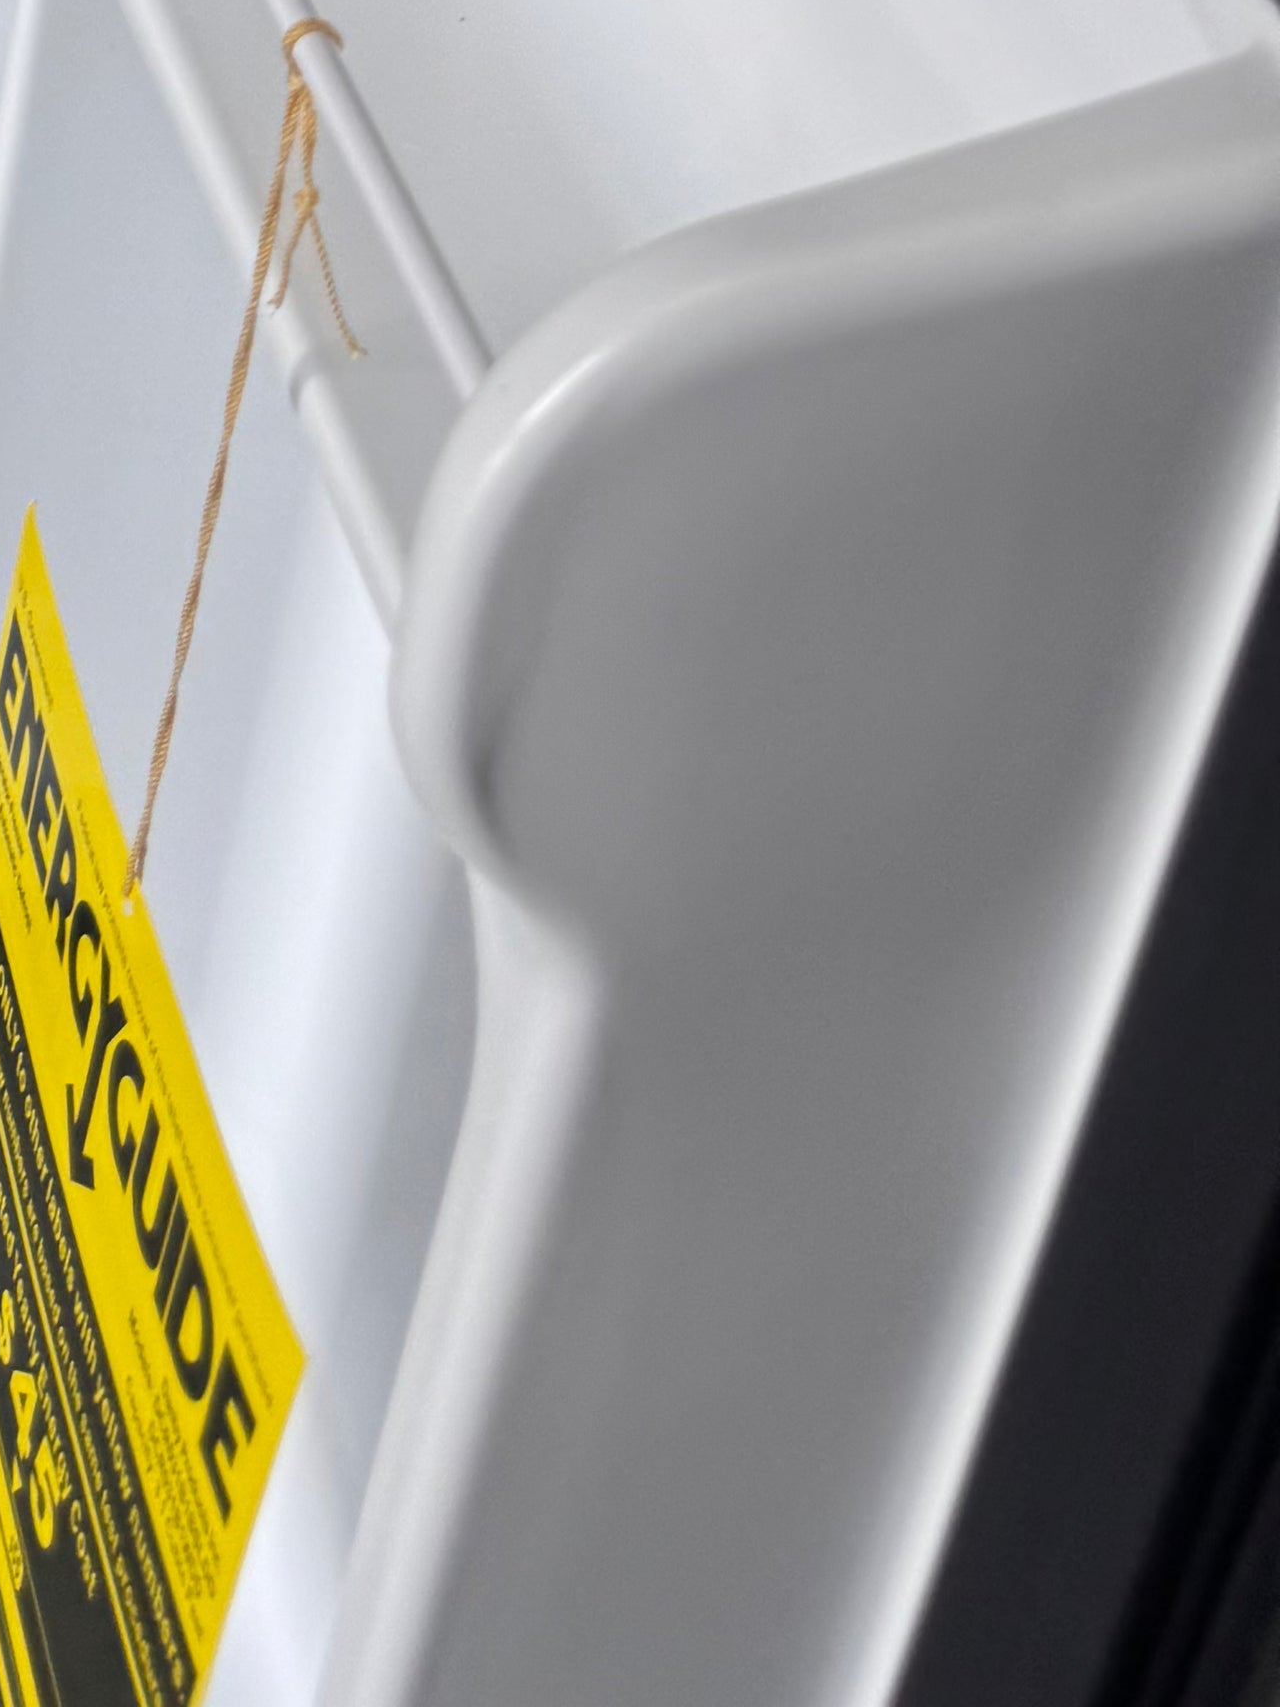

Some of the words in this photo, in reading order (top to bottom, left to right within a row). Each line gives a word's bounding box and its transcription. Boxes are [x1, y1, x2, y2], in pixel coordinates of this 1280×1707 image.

[12, 1249, 40, 1366] Yearly
[38, 1362, 72, 1501] Energy
[70, 1499, 96, 1599] Cost
[24, 1094, 49, 1182] other
[45, 1177, 75, 1292] labels
[74, 1290, 97, 1375] with
[93, 1373, 132, 1501] yellow
